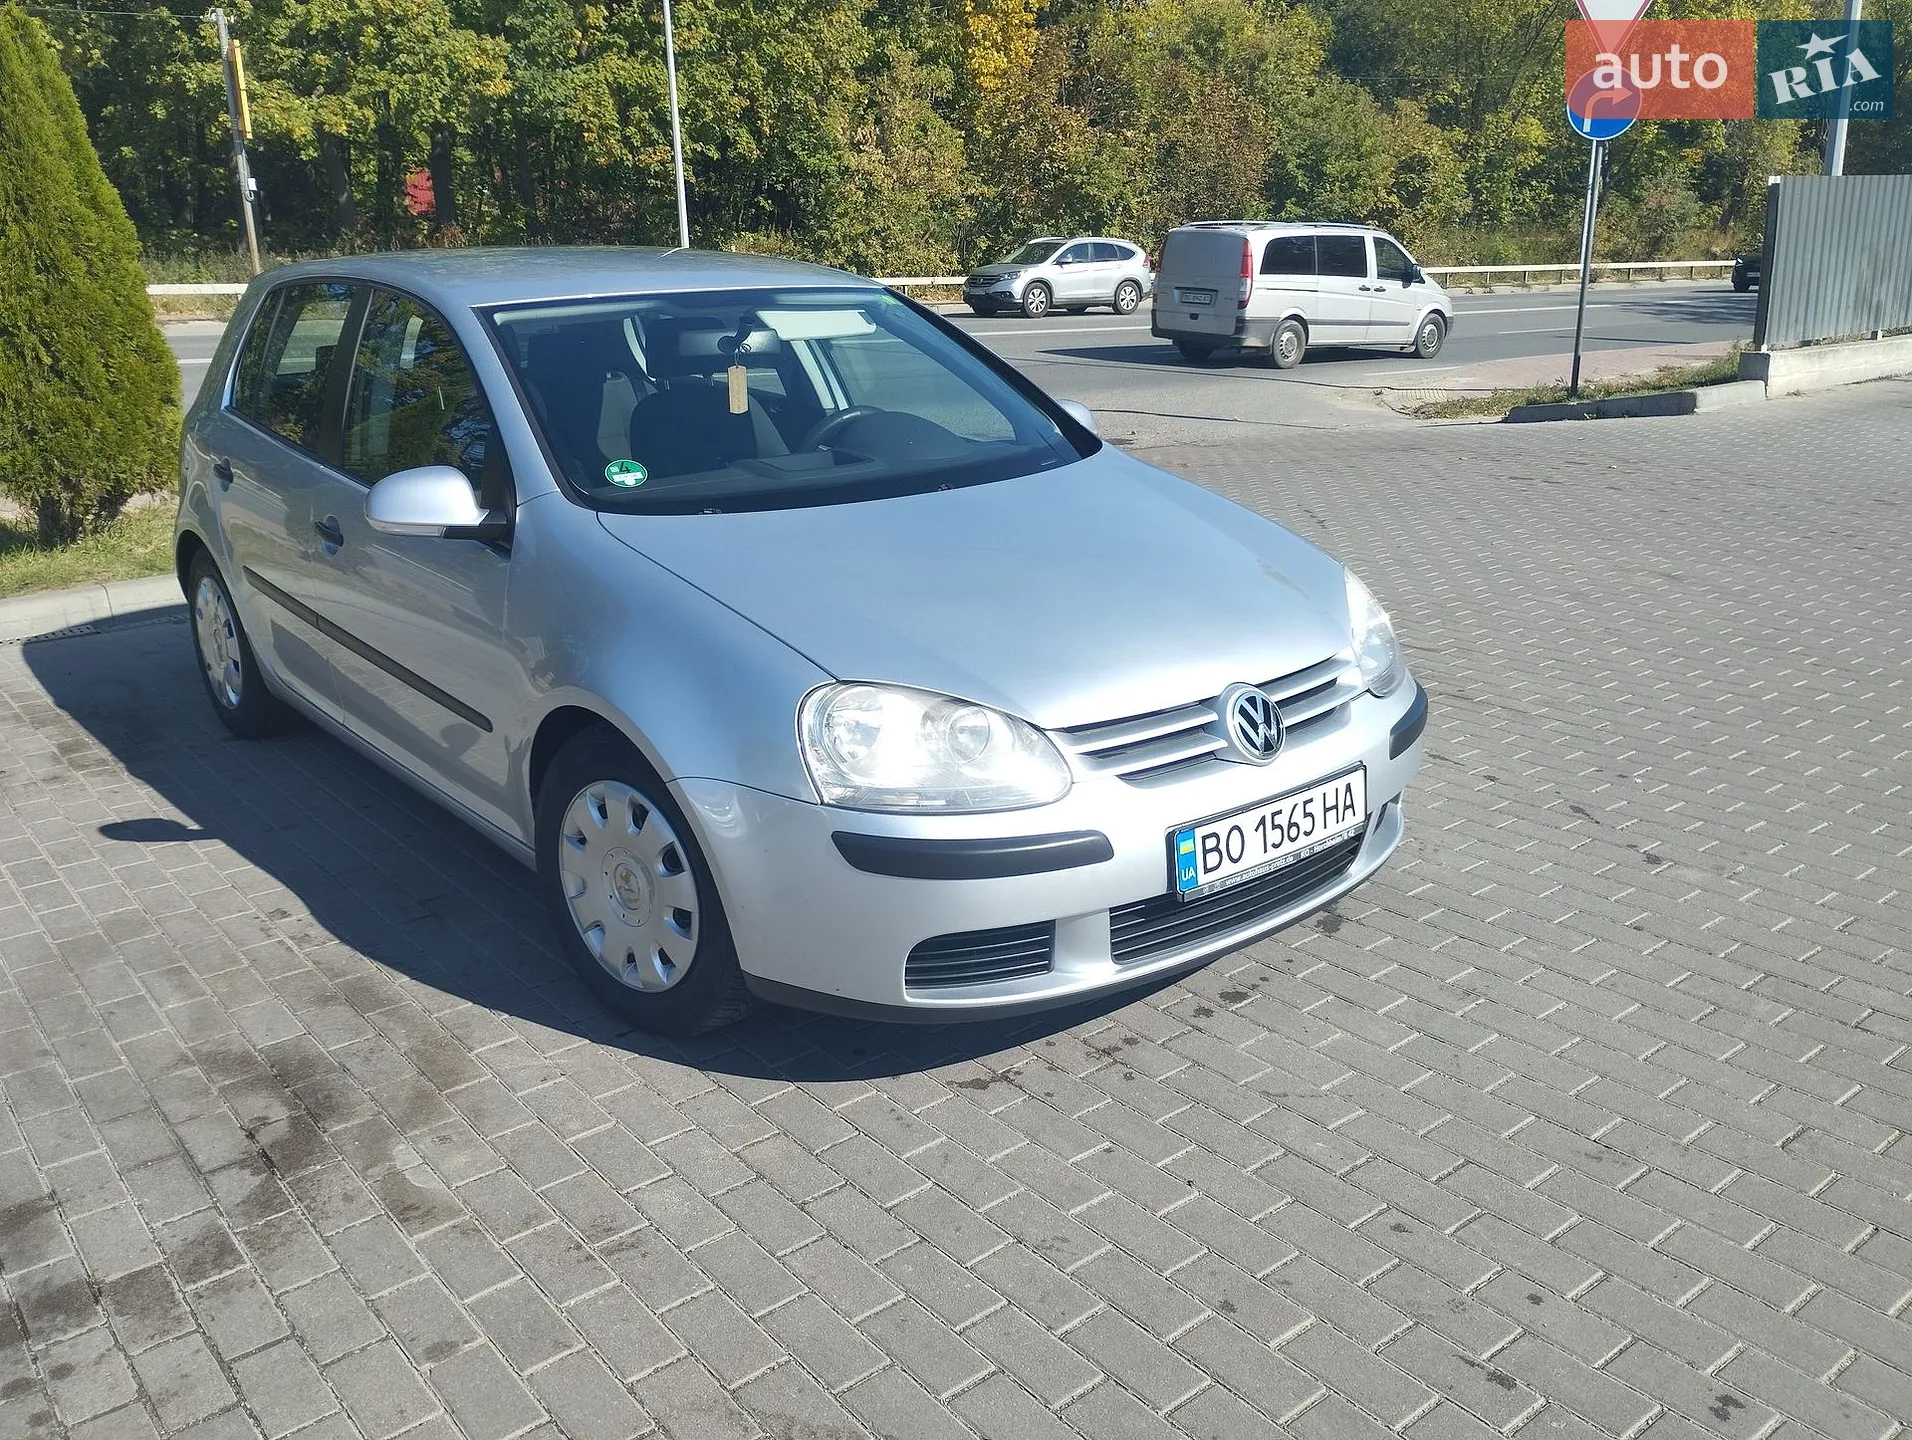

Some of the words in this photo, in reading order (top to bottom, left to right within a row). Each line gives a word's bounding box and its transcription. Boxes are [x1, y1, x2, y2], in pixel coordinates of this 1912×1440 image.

[619, 460, 631, 474] 4
[1200, 824, 1246, 875] BO
[1254, 797, 1316, 854] 1565
[1322, 782, 1356, 830] HA
[1181, 868, 1196, 882] UA
